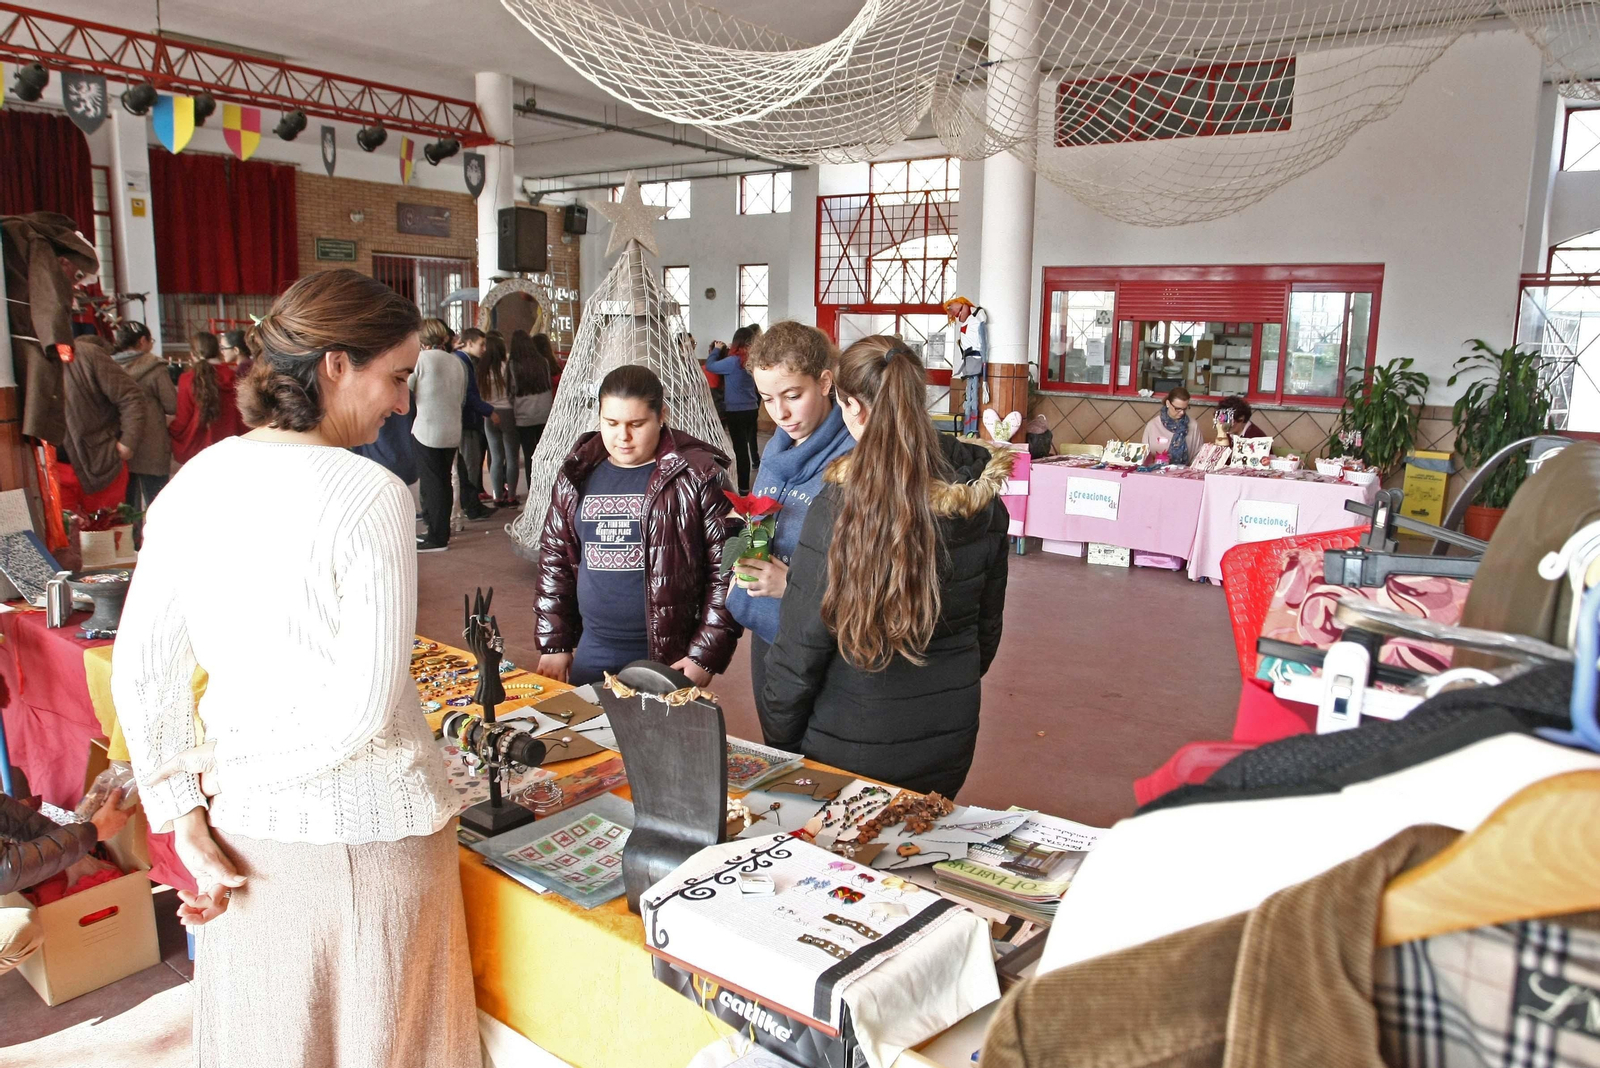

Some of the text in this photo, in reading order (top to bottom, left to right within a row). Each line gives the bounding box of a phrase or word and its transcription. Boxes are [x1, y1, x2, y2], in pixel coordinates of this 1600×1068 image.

[1074, 490, 1112, 502] Creaciones
[1244, 514, 1288, 527] Creaciones
[719, 990, 790, 1042] catlike
